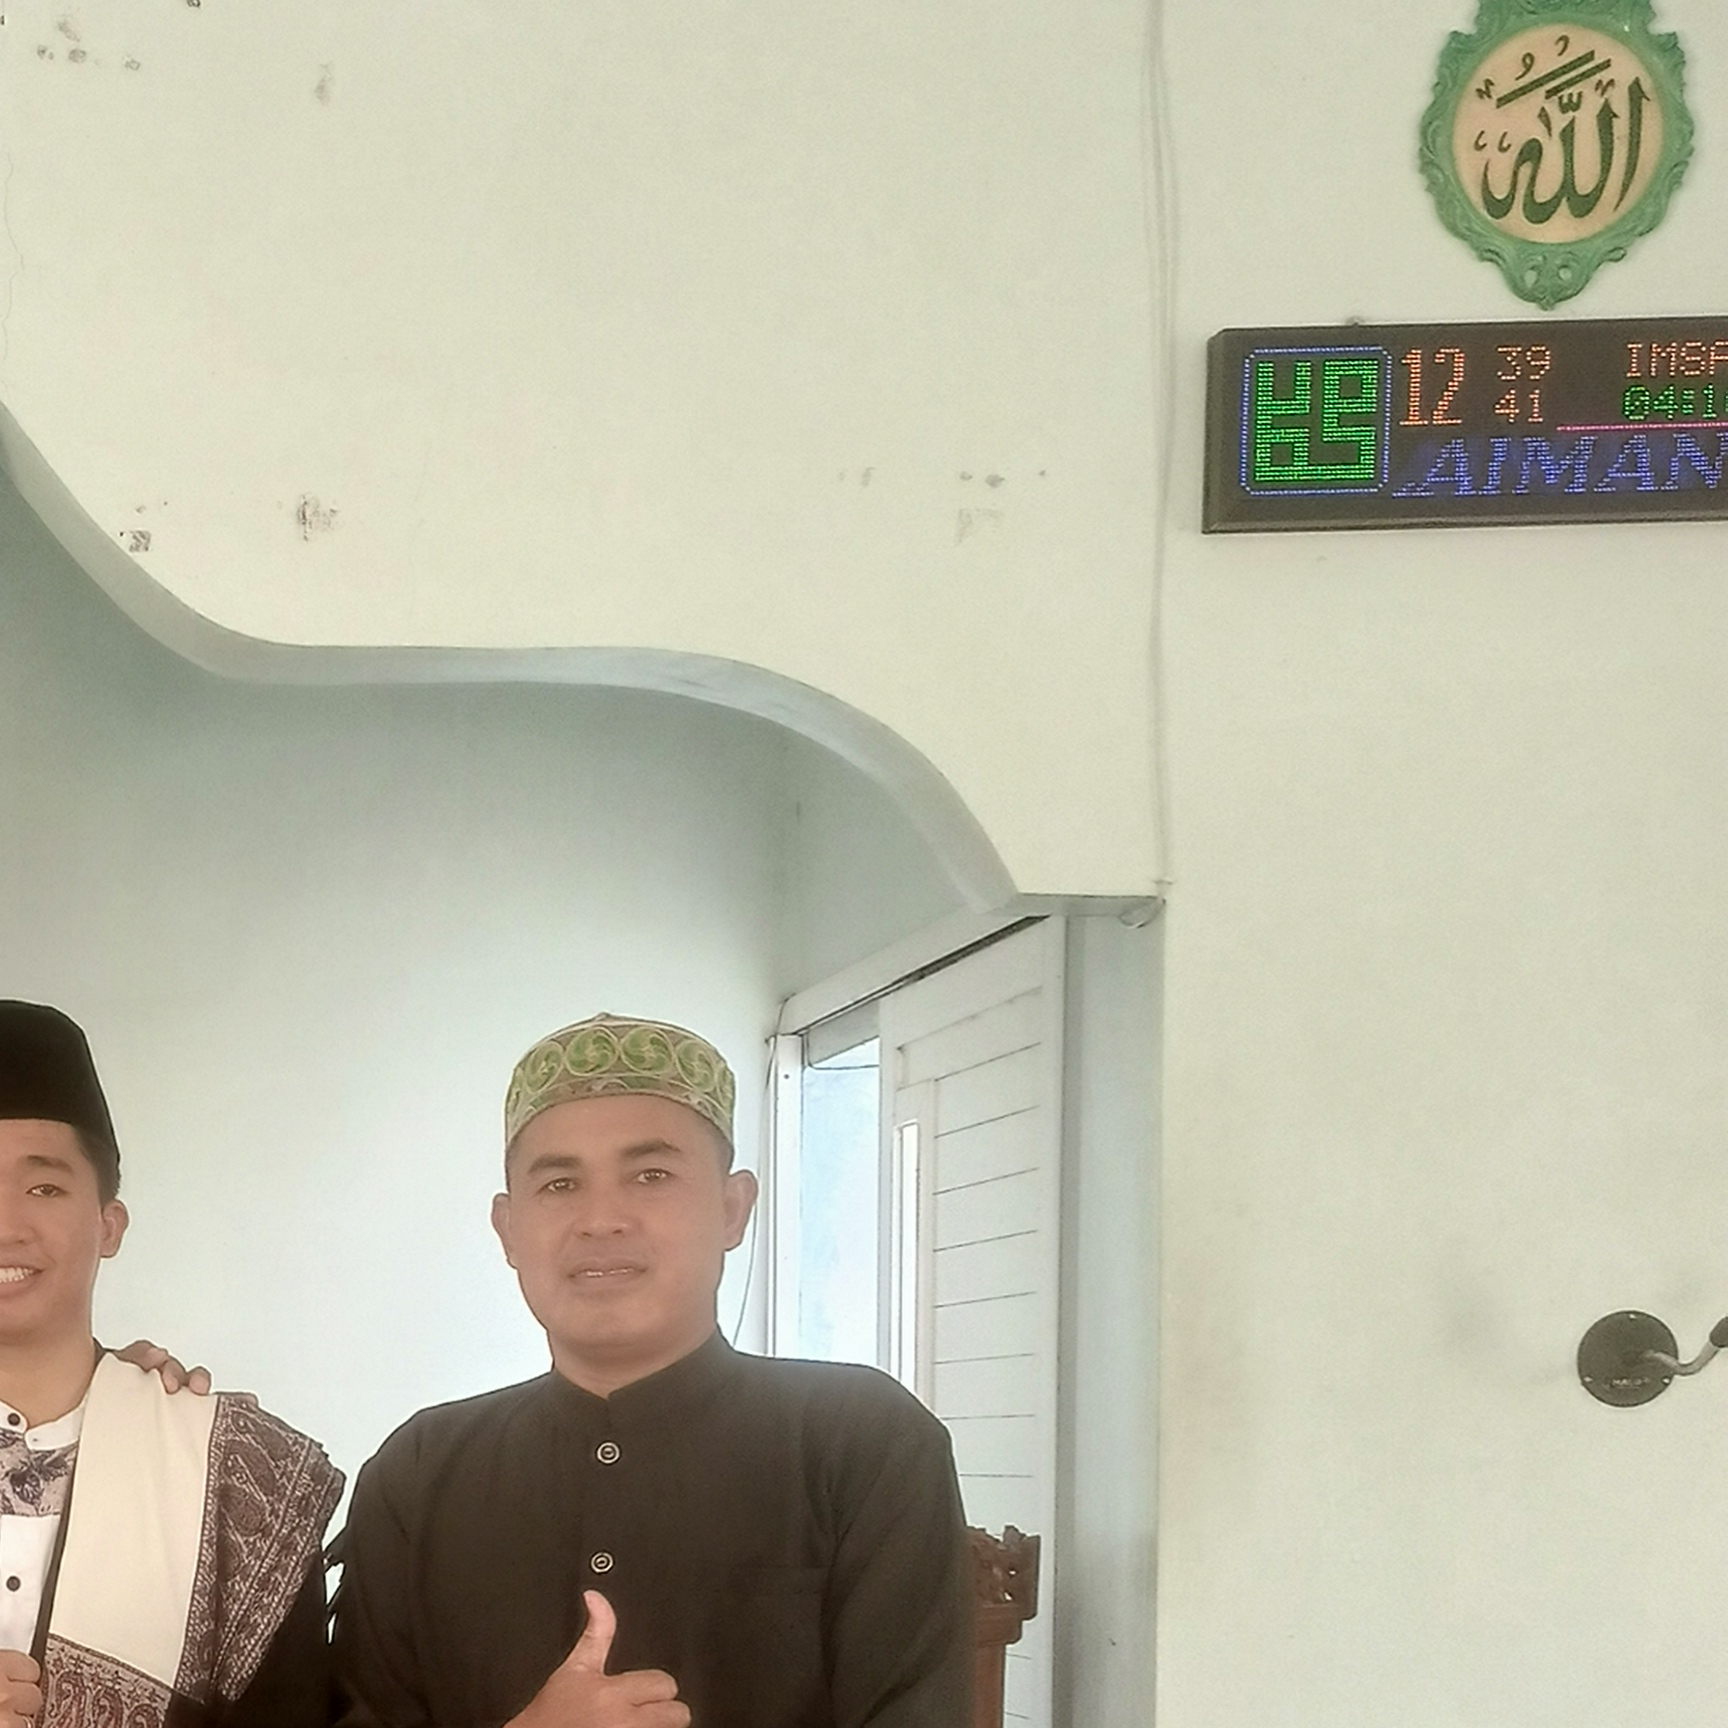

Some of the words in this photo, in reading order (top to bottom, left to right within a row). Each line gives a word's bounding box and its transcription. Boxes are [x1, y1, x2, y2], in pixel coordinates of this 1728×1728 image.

[1497, 346, 1551, 380] 39
[1399, 348, 1465, 425] 12
[1623, 384, 1728, 421] 04:1
[1494, 389, 1544, 423] 41
[1392, 431, 1728, 498] AIMAN
